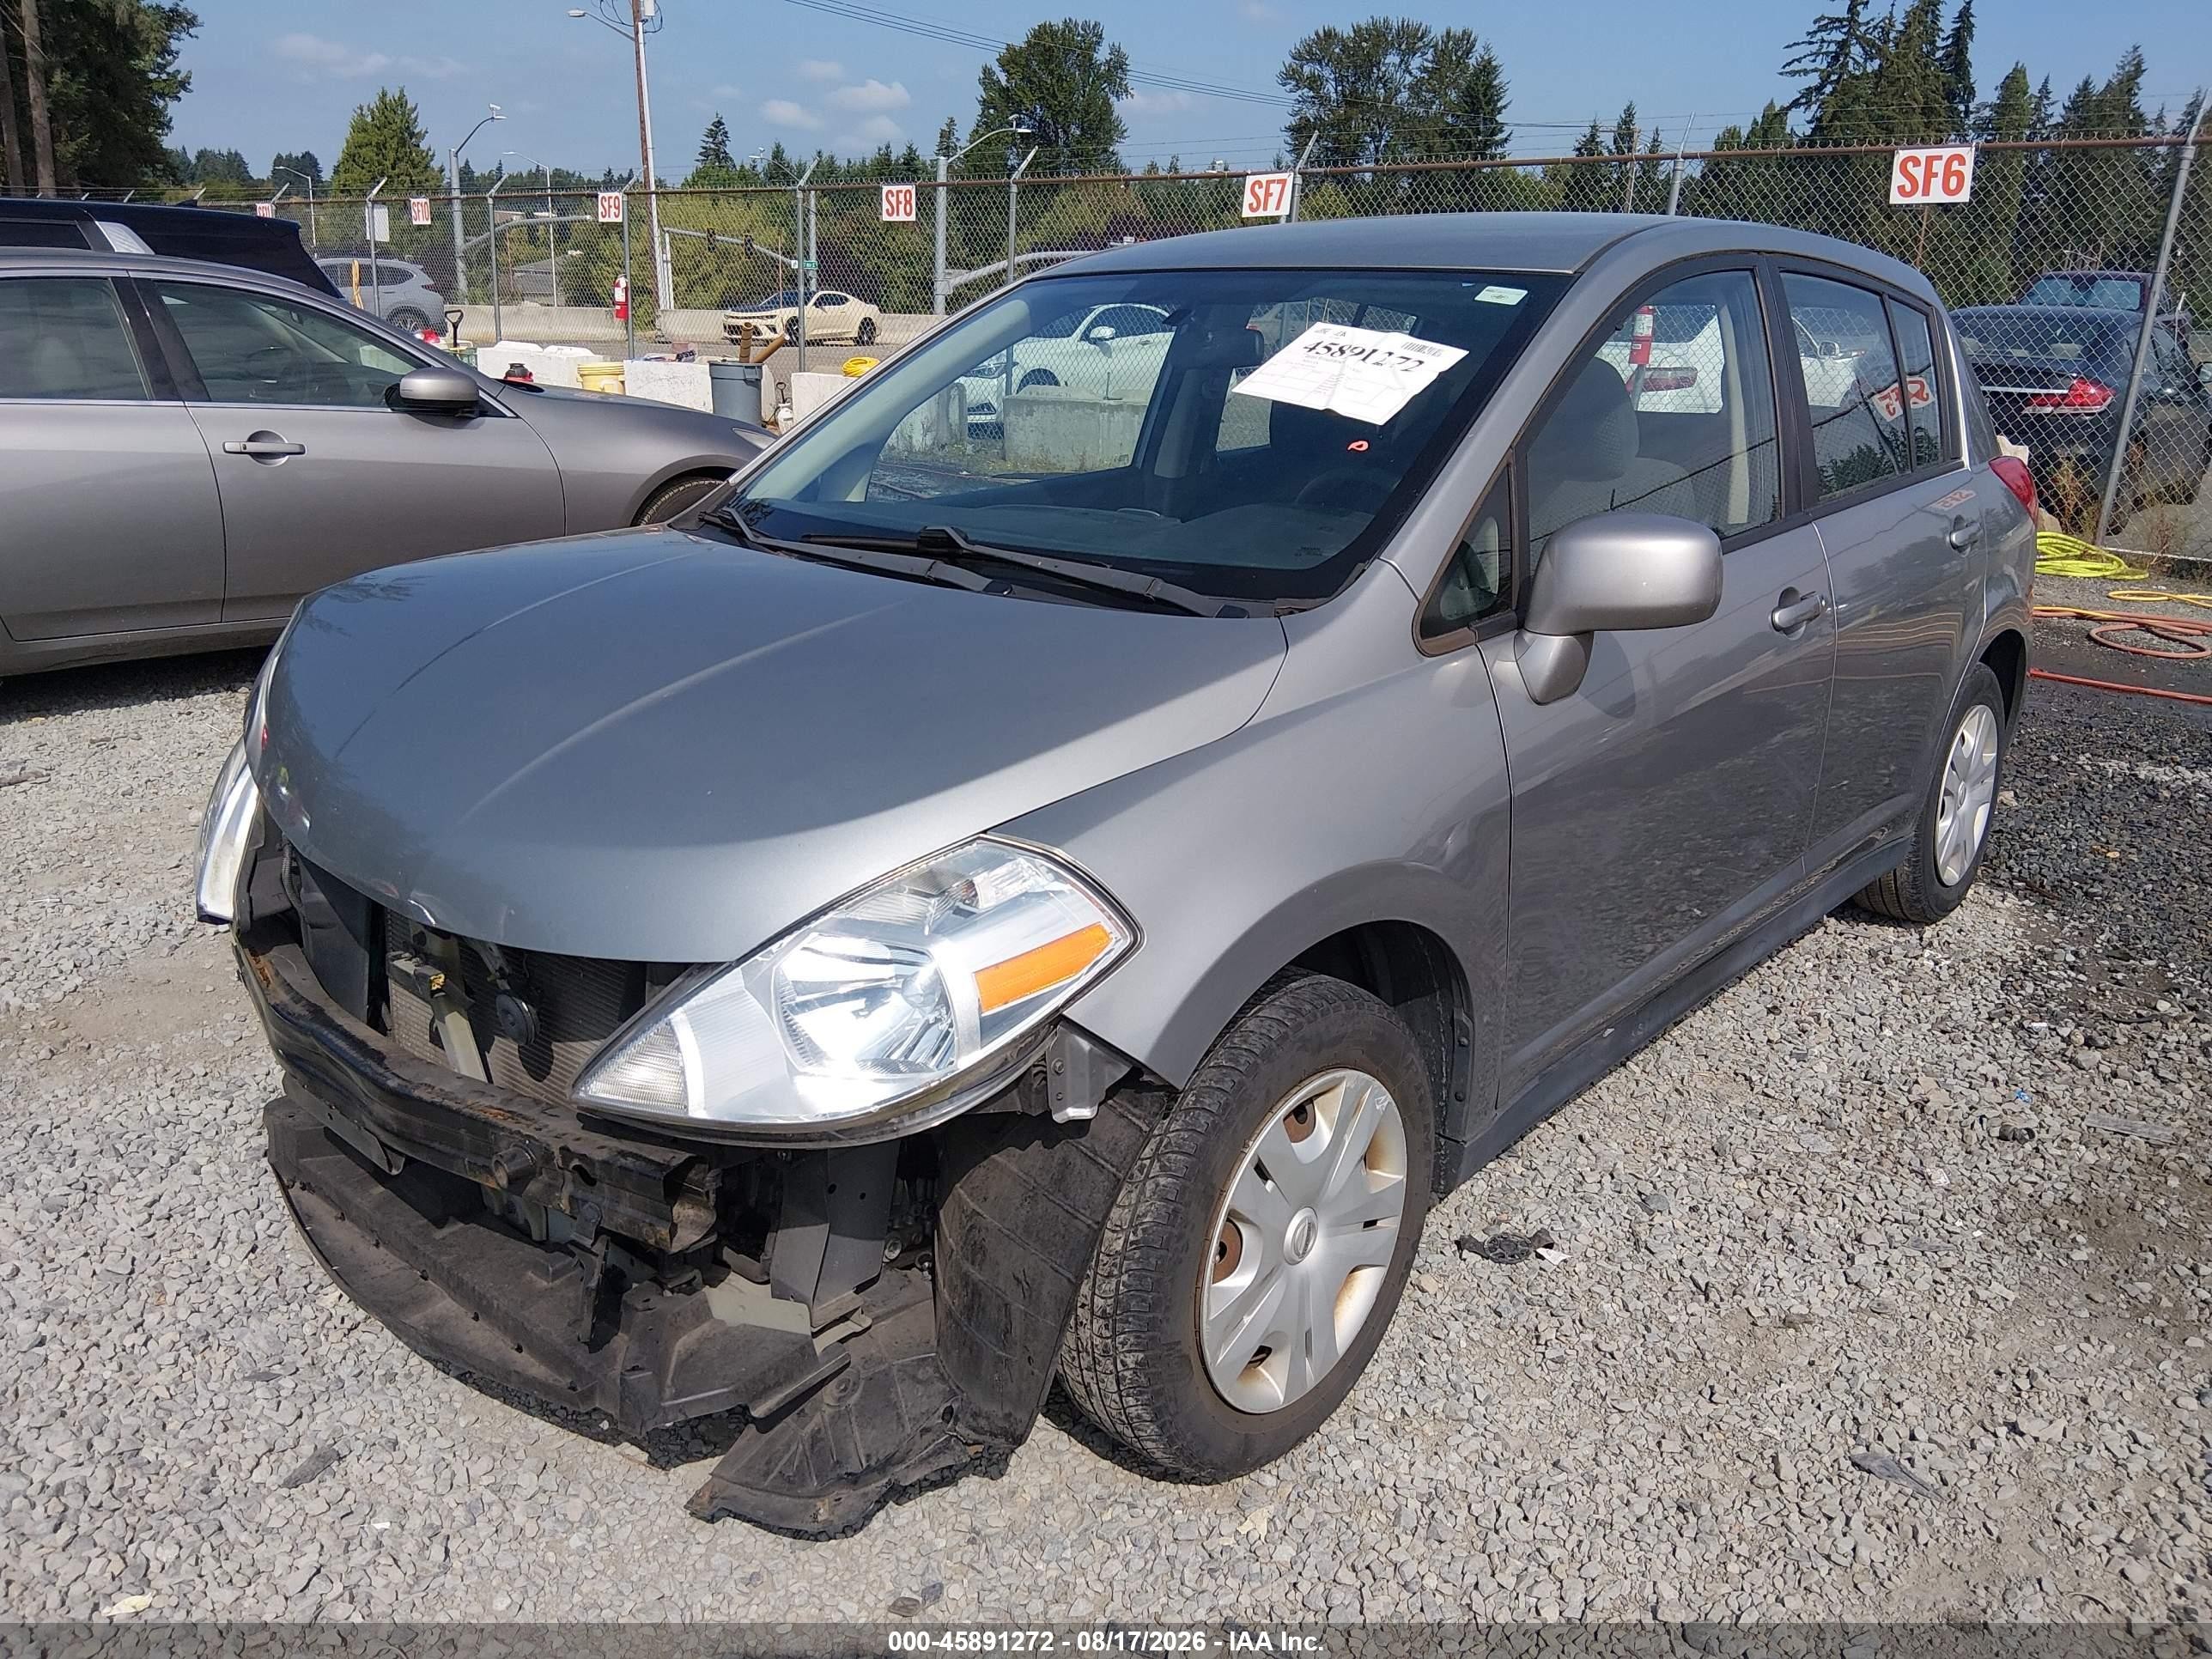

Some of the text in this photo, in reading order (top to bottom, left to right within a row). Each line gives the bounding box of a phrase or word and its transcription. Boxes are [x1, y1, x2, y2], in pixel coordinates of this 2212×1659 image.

[1897, 154, 1966, 198] SF6
[601, 195, 621, 219] SF9
[885, 189, 913, 217] SF8
[1249, 179, 1287, 213] SF7
[412, 201, 429, 222] SF10
[1303, 340, 1425, 372] 45891272
